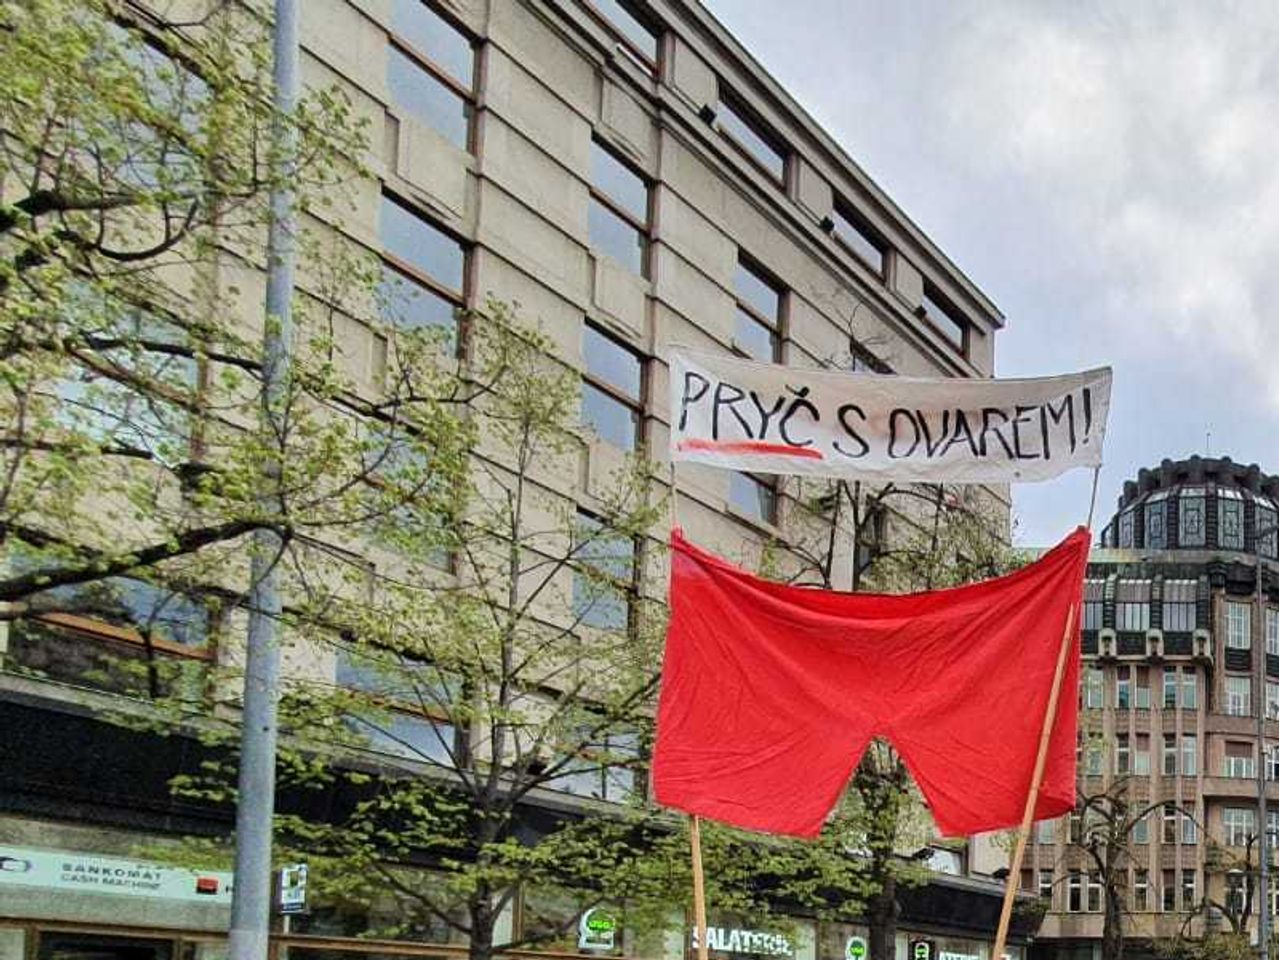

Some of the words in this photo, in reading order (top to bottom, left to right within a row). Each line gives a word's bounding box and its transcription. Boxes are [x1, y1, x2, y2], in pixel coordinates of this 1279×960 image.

[679, 371, 820, 447] PRYČ
[833, 404, 870, 459] S
[888, 388, 1092, 461] OVAREM!
[62, 863, 161, 880] BANKOMAT
[61, 874, 98, 884] CASH
[102, 879, 161, 890] MACHINE
